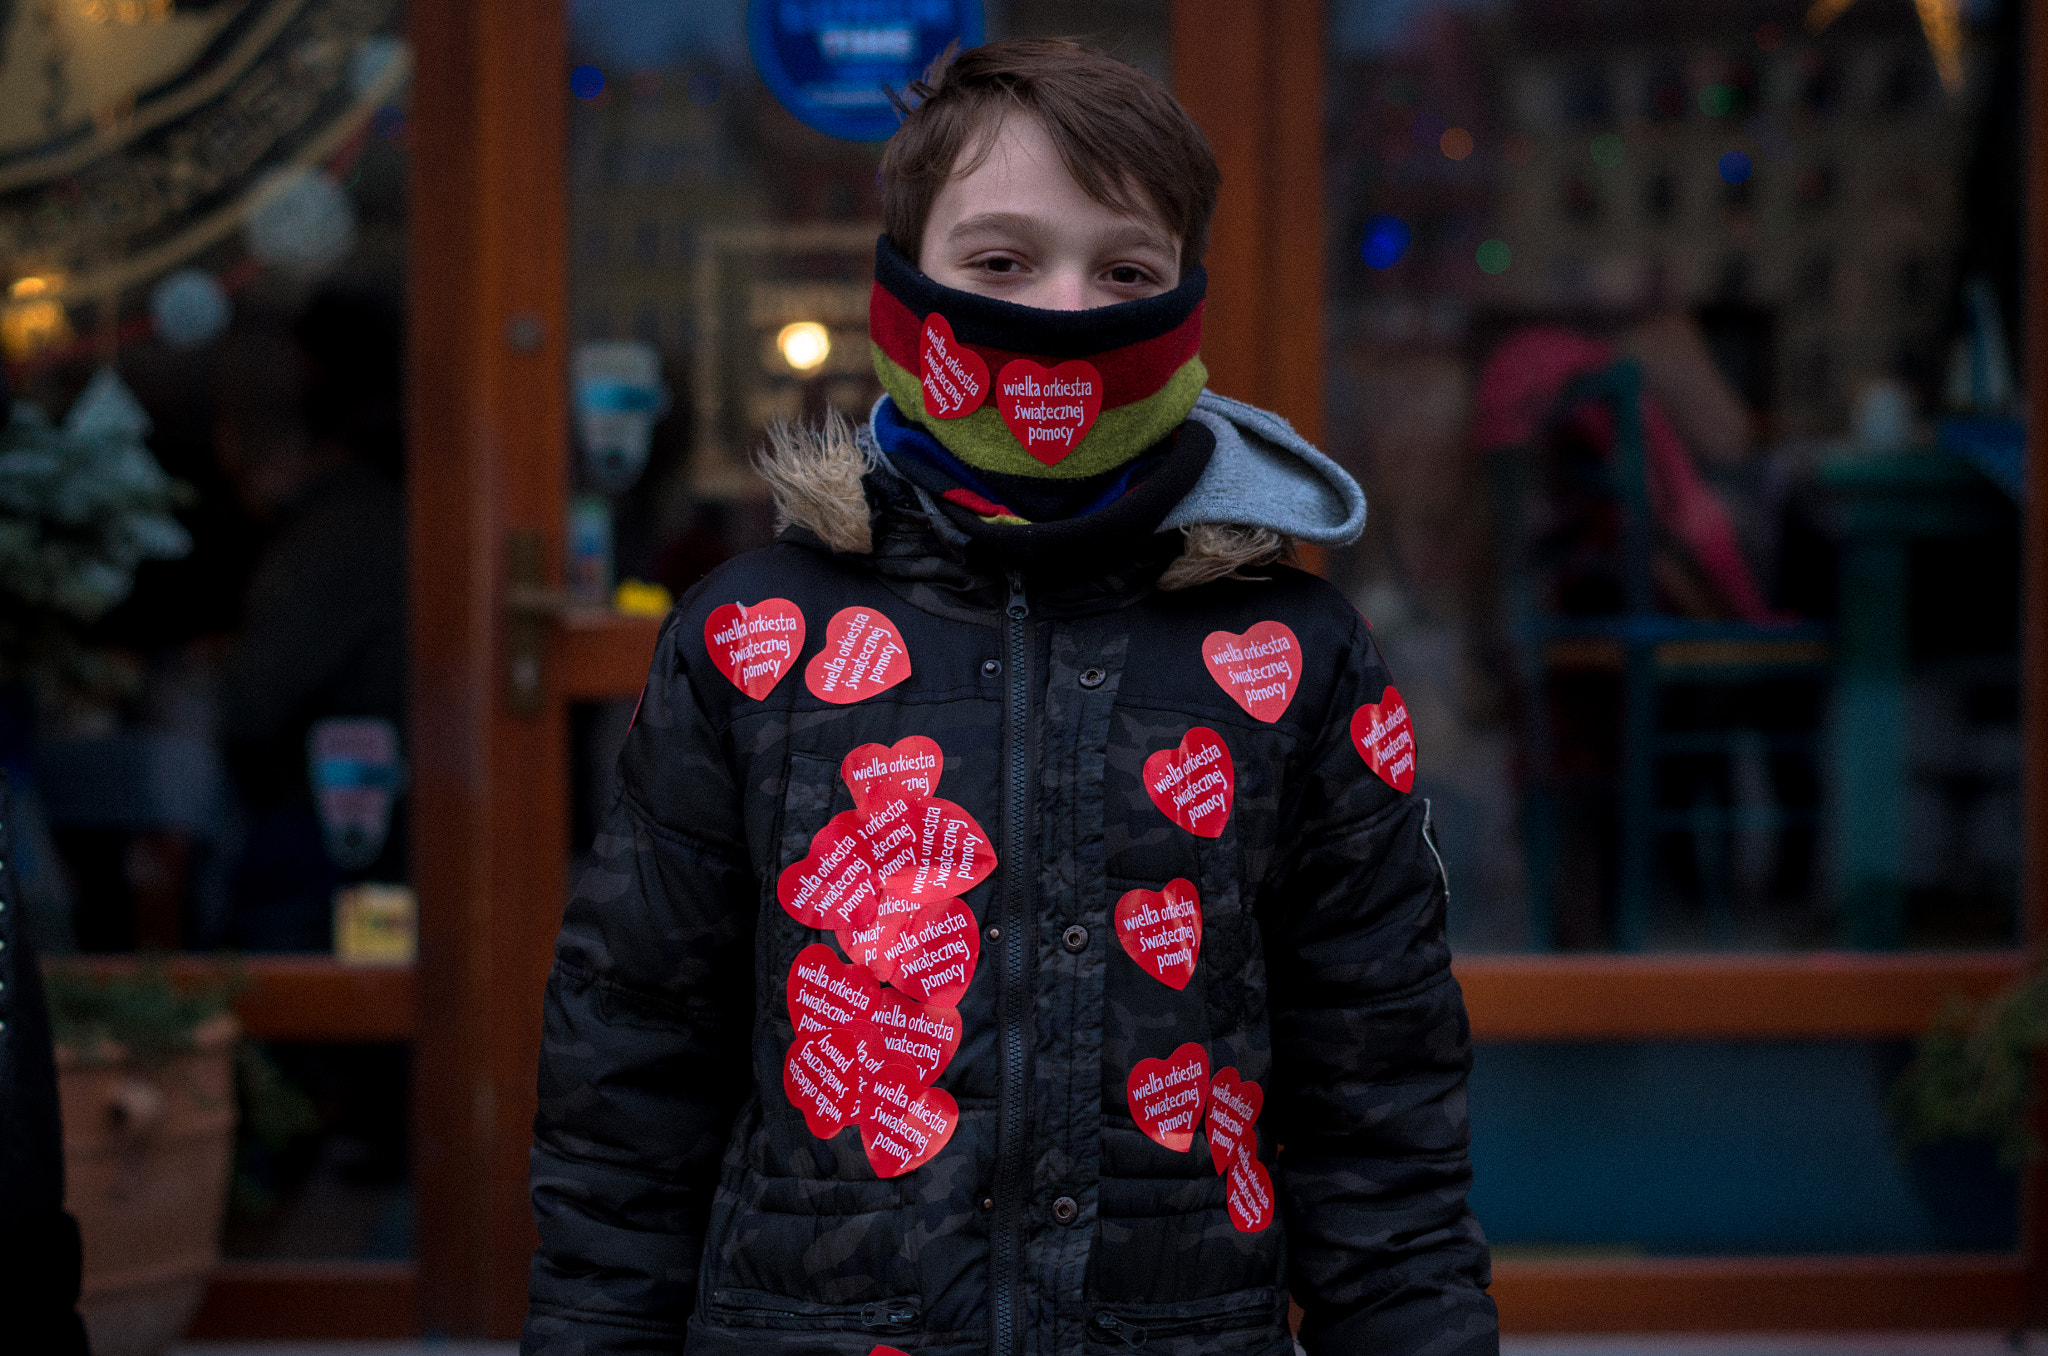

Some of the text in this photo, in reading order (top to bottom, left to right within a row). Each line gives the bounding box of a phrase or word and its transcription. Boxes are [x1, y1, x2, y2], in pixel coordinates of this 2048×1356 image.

[924, 346, 966, 411] świątecznej
[926, 326, 979, 396] wielka orkiestra
[923, 372, 950, 415] pomocy
[1003, 375, 1092, 397] wielka orkiestra
[1014, 399, 1084, 427] świątecznej
[1028, 426, 1075, 446] pomocy
[713, 612, 797, 646] wielka orkiestra
[729, 634, 791, 666] świątecznej
[820, 612, 870, 692] wielka orkiestra
[840, 625, 892, 691] świątecznej
[868, 641, 903, 684] pomocy
[1211, 635, 1291, 665] wielka orkiestra
[743, 657, 781, 685] pomocy
[1228, 655, 1292, 685] świątecznej
[1244, 681, 1286, 708] pomocy
[1361, 704, 1407, 749] wielka orkiestra
[852, 751, 936, 782] wielka orkiestra
[1154, 744, 1222, 795] wielka orkiestra
[1389, 752, 1414, 783] pomocy
[1172, 764, 1228, 810] świątecznej
[865, 798, 908, 836] orkiestra
[1188, 792, 1226, 828] pomocy
[872, 818, 916, 862] ątecznej
[928, 818, 968, 889] świątecznej
[957, 832, 983, 880] pomocy
[791, 835, 856, 909] wielka orkiestra
[811, 853, 872, 917] świątecznej
[878, 846, 917, 885] pomocy
[837, 878, 876, 923] pomocy
[1123, 895, 1195, 931] wielka orkiestra
[884, 931, 920, 962] wielka
[919, 912, 967, 944] orkiestra
[1140, 919, 1196, 952] świątecznej
[900, 933, 970, 979] świątecznej
[1157, 947, 1192, 974] pomocy
[797, 962, 870, 1011] wielka orkiestra
[921, 963, 965, 996] pomocy
[908, 1012, 954, 1041] orkiestra
[798, 1040, 849, 1103] świątecznej
[817, 1033, 854, 1074] pomocy
[789, 1057, 843, 1124] wielka orkiestra
[1132, 1060, 1202, 1101] wielka orkiestra
[1212, 1082, 1231, 1104] wielka
[873, 1080, 909, 1108] wielka
[907, 1099, 948, 1135] orkiestra
[1144, 1082, 1200, 1121] świątecznej
[870, 1101, 932, 1156] świątecznej
[1158, 1109, 1193, 1140] pomocy
[1211, 1128, 1235, 1157] pomocy
[870, 1131, 912, 1168] pomocy
[1229, 1189, 1254, 1228] pomocy
[1247, 1169, 1269, 1209] orkiestra
